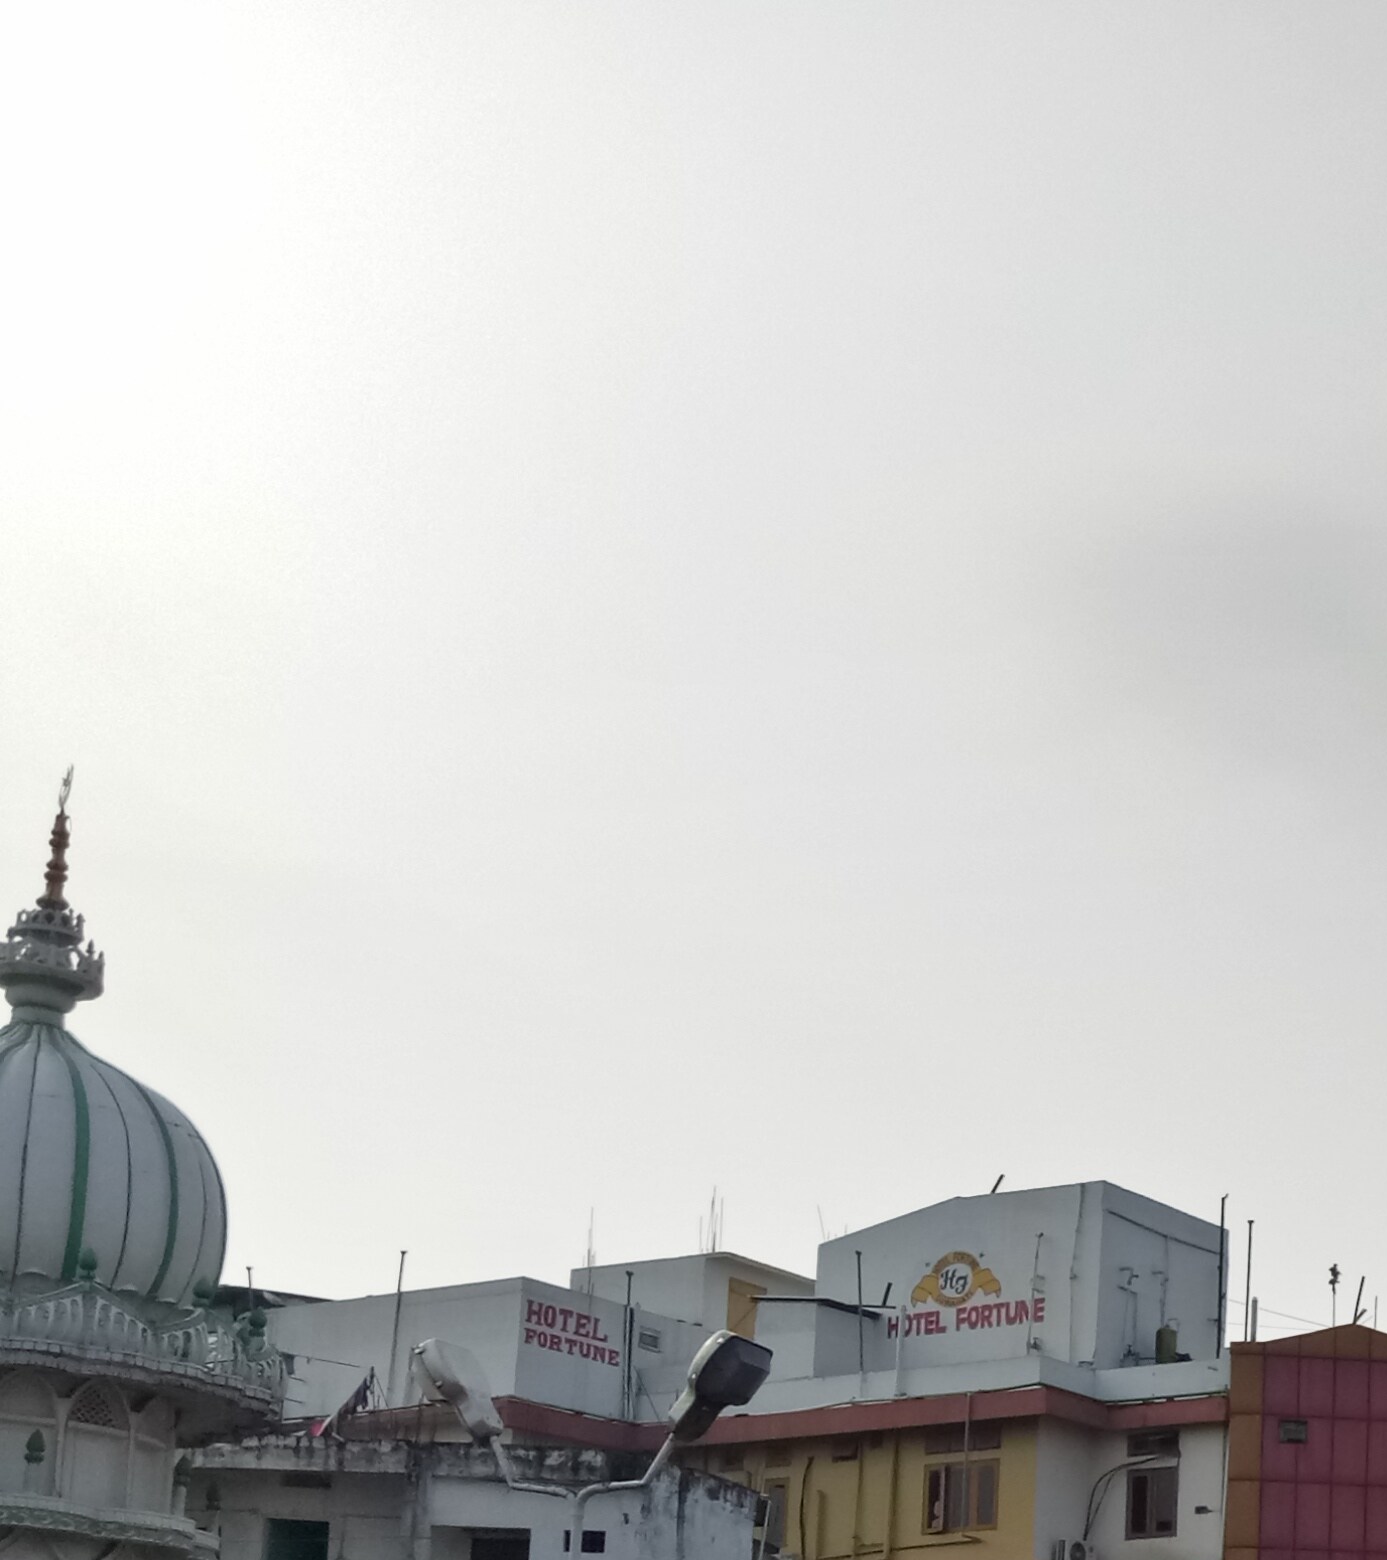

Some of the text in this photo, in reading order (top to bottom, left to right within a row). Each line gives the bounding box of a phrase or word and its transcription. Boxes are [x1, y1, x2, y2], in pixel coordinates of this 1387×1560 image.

[525, 1299, 608, 1342] HOTEL
[887, 1310, 947, 1339] HOTEL
[955, 1297, 1046, 1331] FORTUNE
[523, 1328, 620, 1367] FORTUNE
